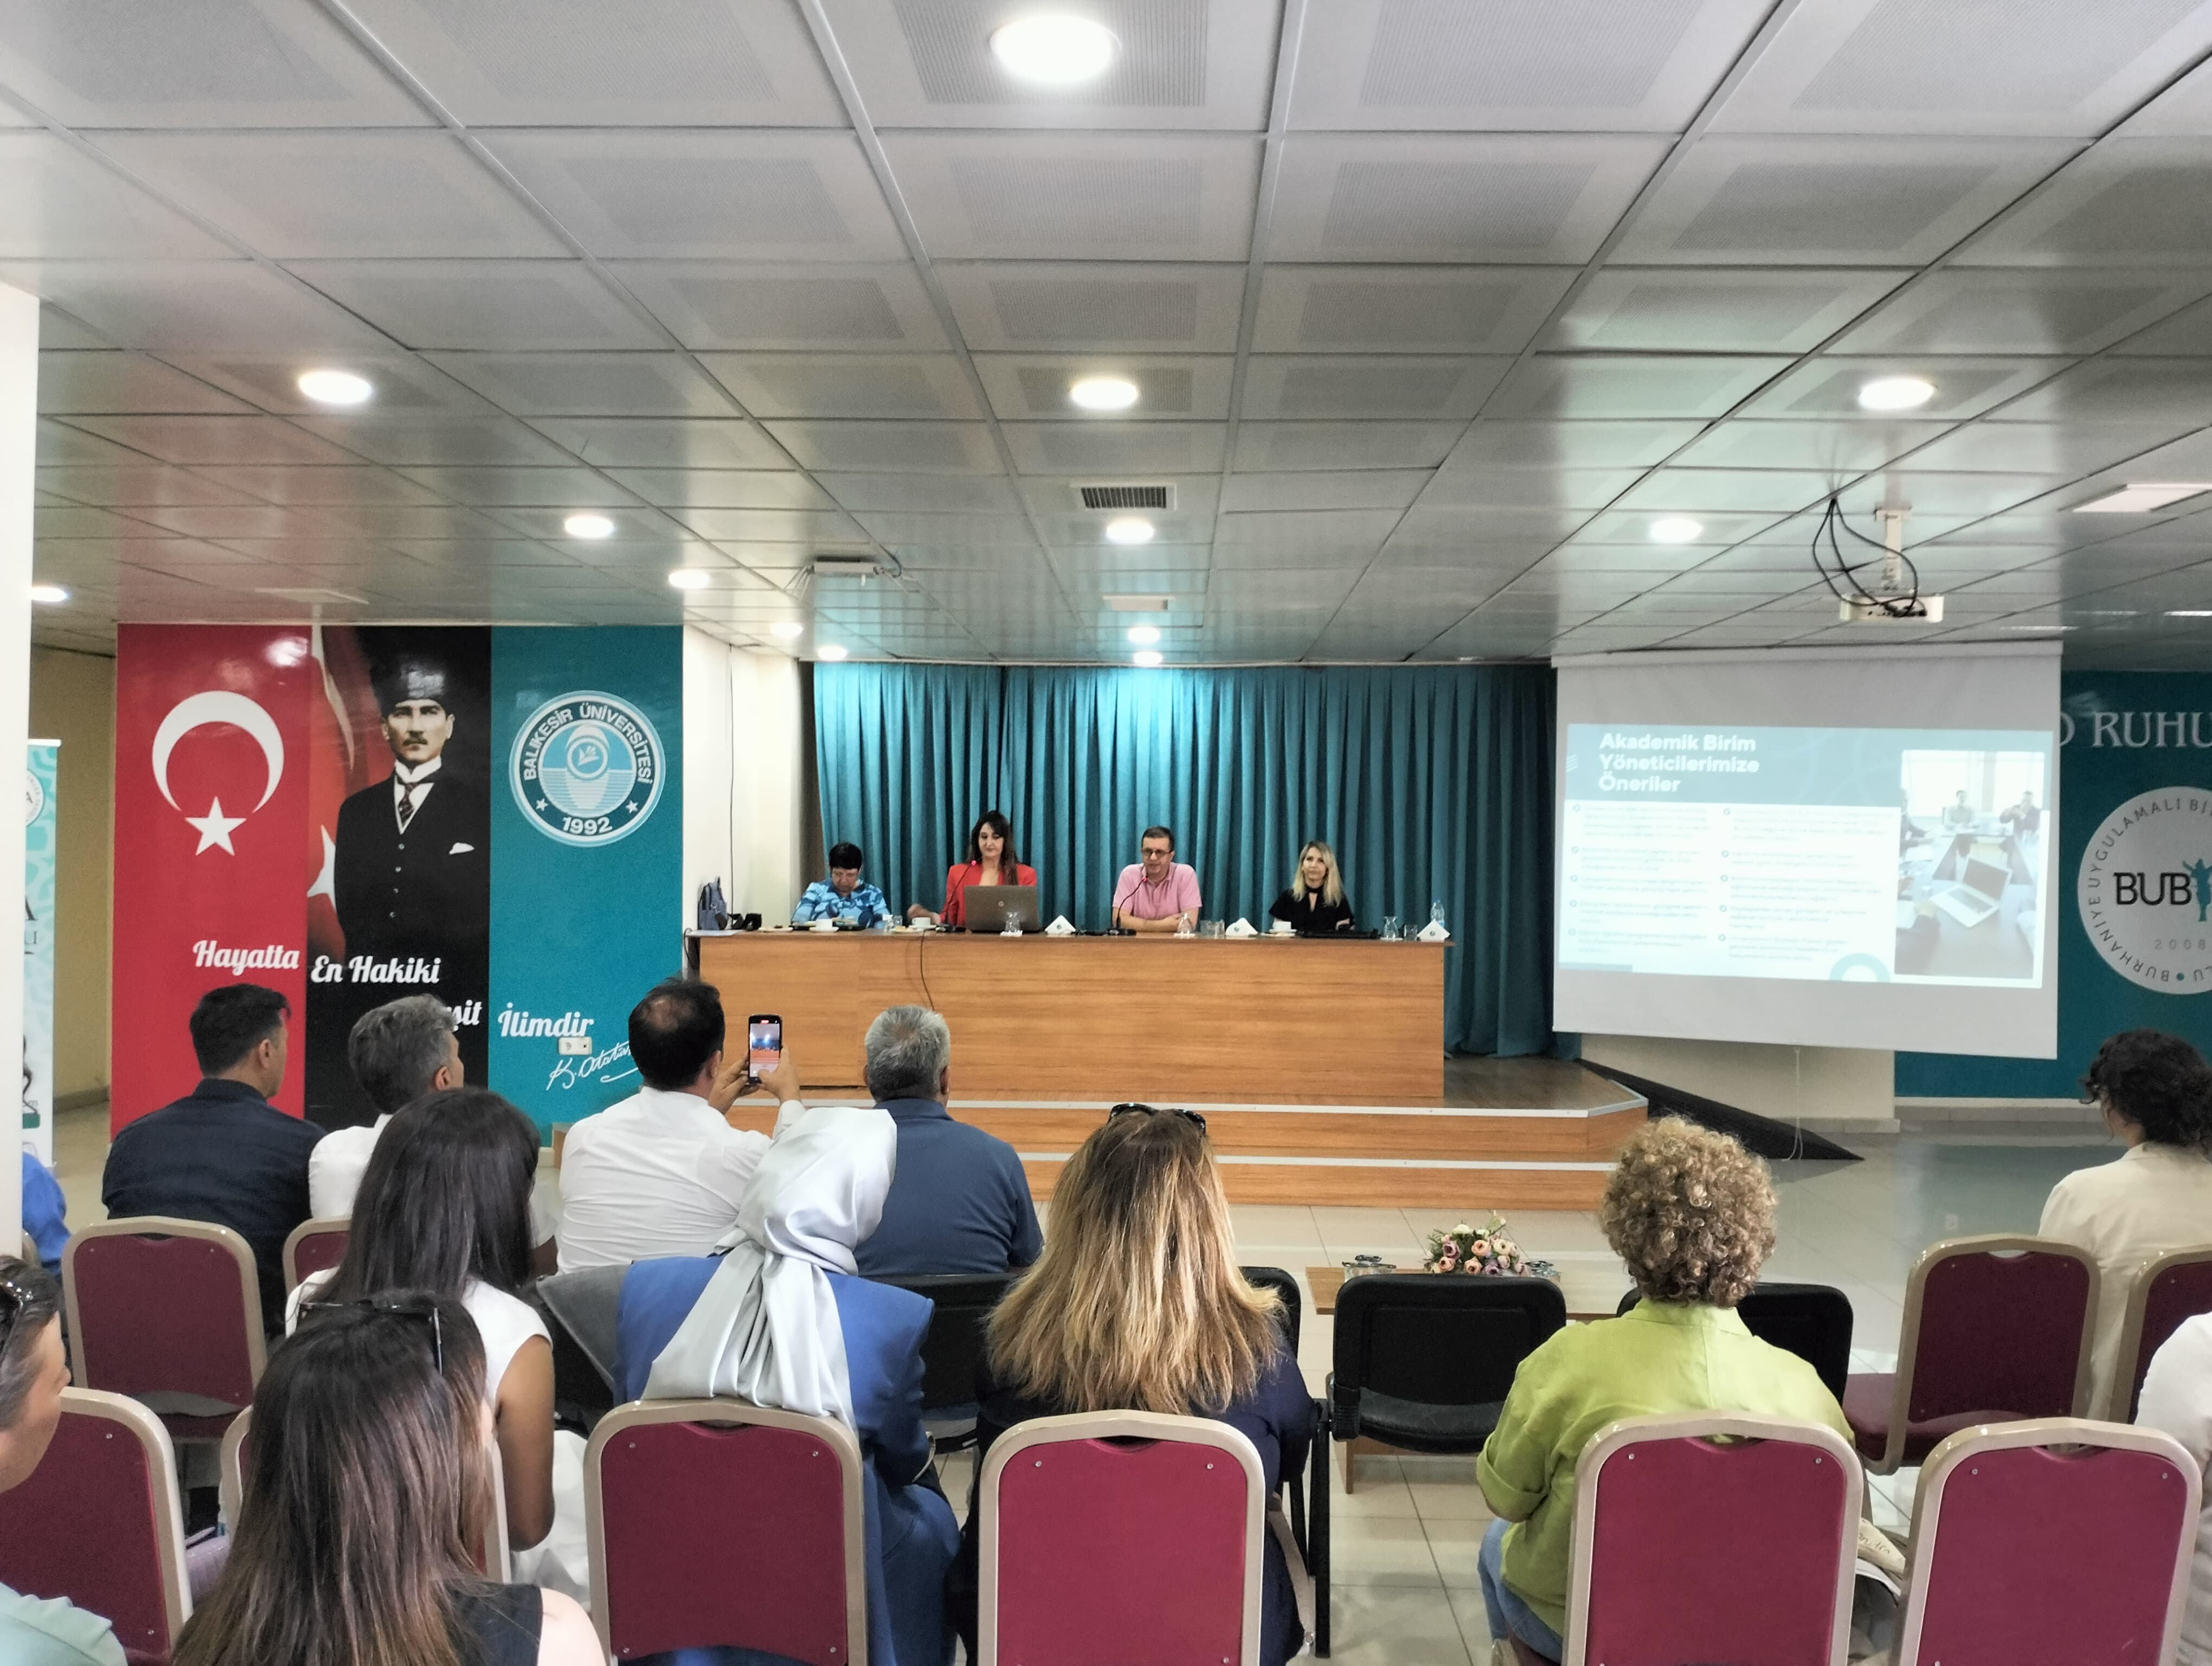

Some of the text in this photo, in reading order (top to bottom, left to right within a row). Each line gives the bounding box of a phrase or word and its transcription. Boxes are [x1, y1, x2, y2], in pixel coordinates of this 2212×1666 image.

[524, 702, 654, 785] BALIKESİR ÜNİVERSİTESİ
[1599, 733, 1757, 752] Akademik Birim
[1599, 753, 1760, 773] Yöneticilerimize
[1598, 771, 1682, 792] Öneriler
[562, 816, 613, 835] 1992
[2088, 798, 2181, 888] UYGULAMALI
[192, 939, 300, 977] Hayatta
[310, 954, 442, 984] En Hakiki
[497, 1002, 595, 1037] İlimdir
